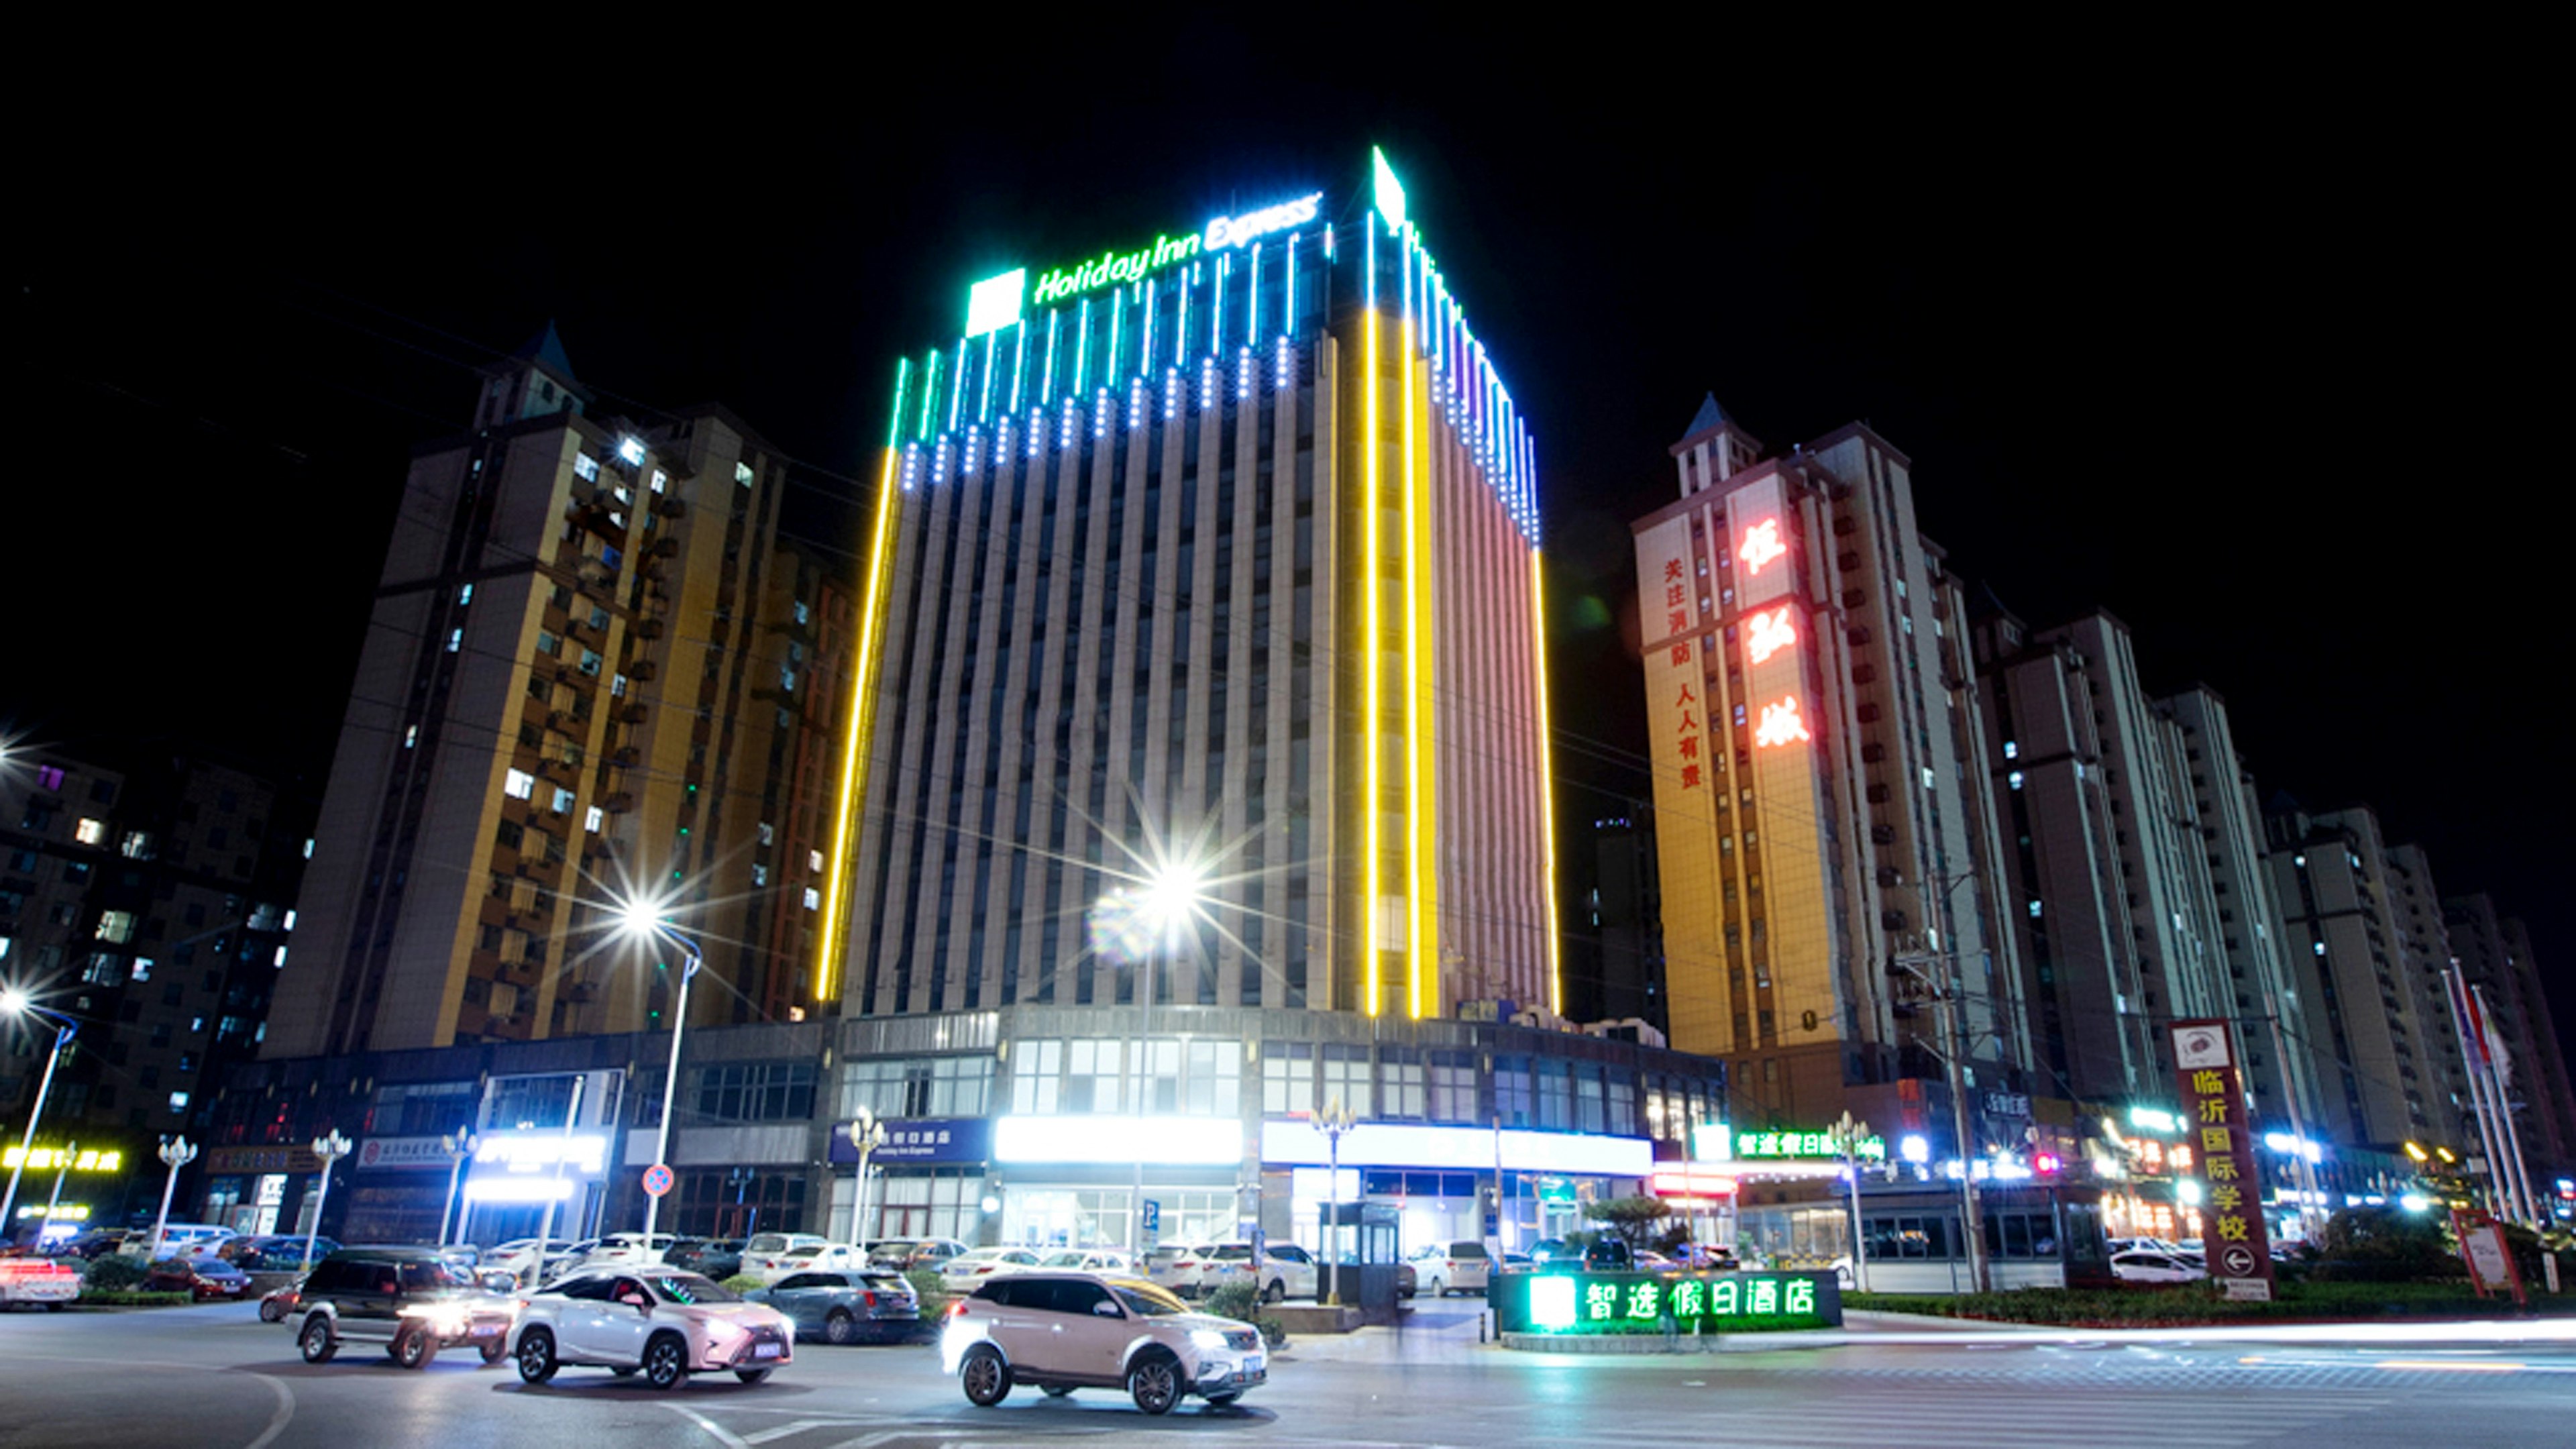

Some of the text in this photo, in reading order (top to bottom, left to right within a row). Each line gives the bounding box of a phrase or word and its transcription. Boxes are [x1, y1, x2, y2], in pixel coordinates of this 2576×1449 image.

[1034, 199, 1318, 304] Holiday Inn Express
[1664, 558, 1701, 790] 关注消防 人人有责
[1737, 1132, 1854, 1155] 智选假日酒
[2192, 1069, 2249, 1242] 临沂国际学校
[1144, 1203, 1155, 1227] P
[1585, 1279, 1814, 1320] 智选假日酒店
